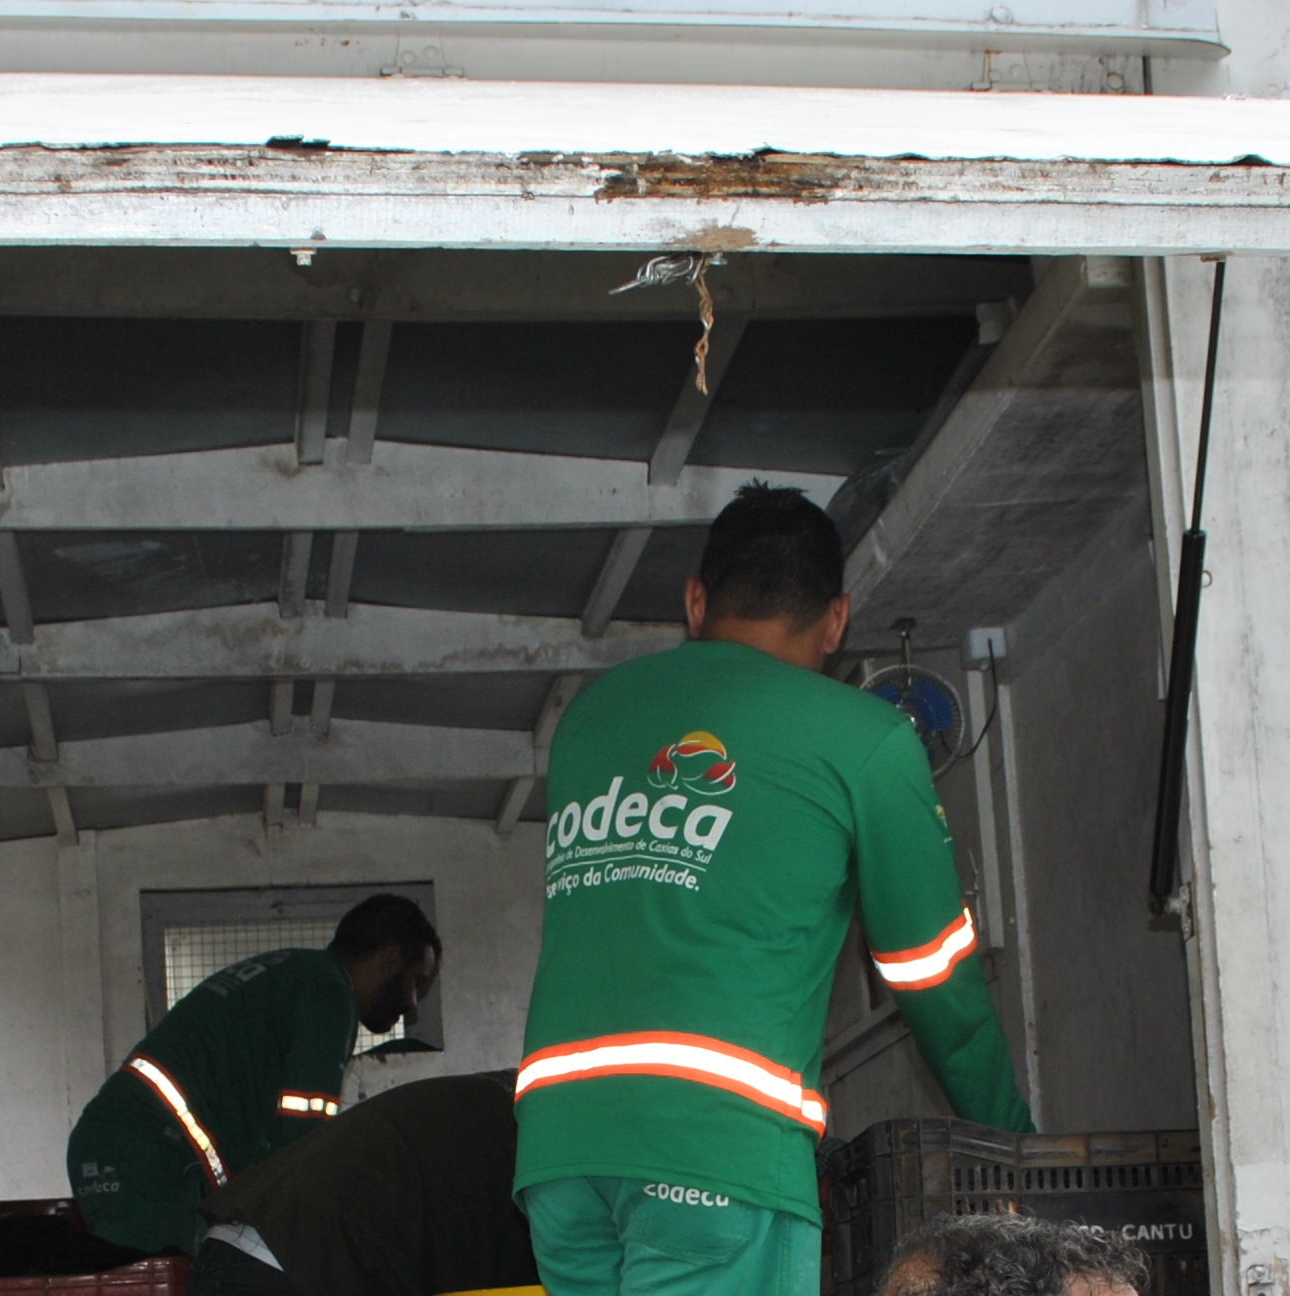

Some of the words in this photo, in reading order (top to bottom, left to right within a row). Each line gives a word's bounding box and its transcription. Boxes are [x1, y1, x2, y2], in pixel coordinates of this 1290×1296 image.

[546, 776, 733, 859] codeca
[635, 839, 647, 850] de
[649, 840, 679, 855] Caxias
[680, 846, 693, 858] do
[694, 849, 713, 864] Sul
[583, 866, 602, 887] da
[604, 862, 700, 892] Comunidade.
[1122, 1223, 1193, 1240] CANTU
